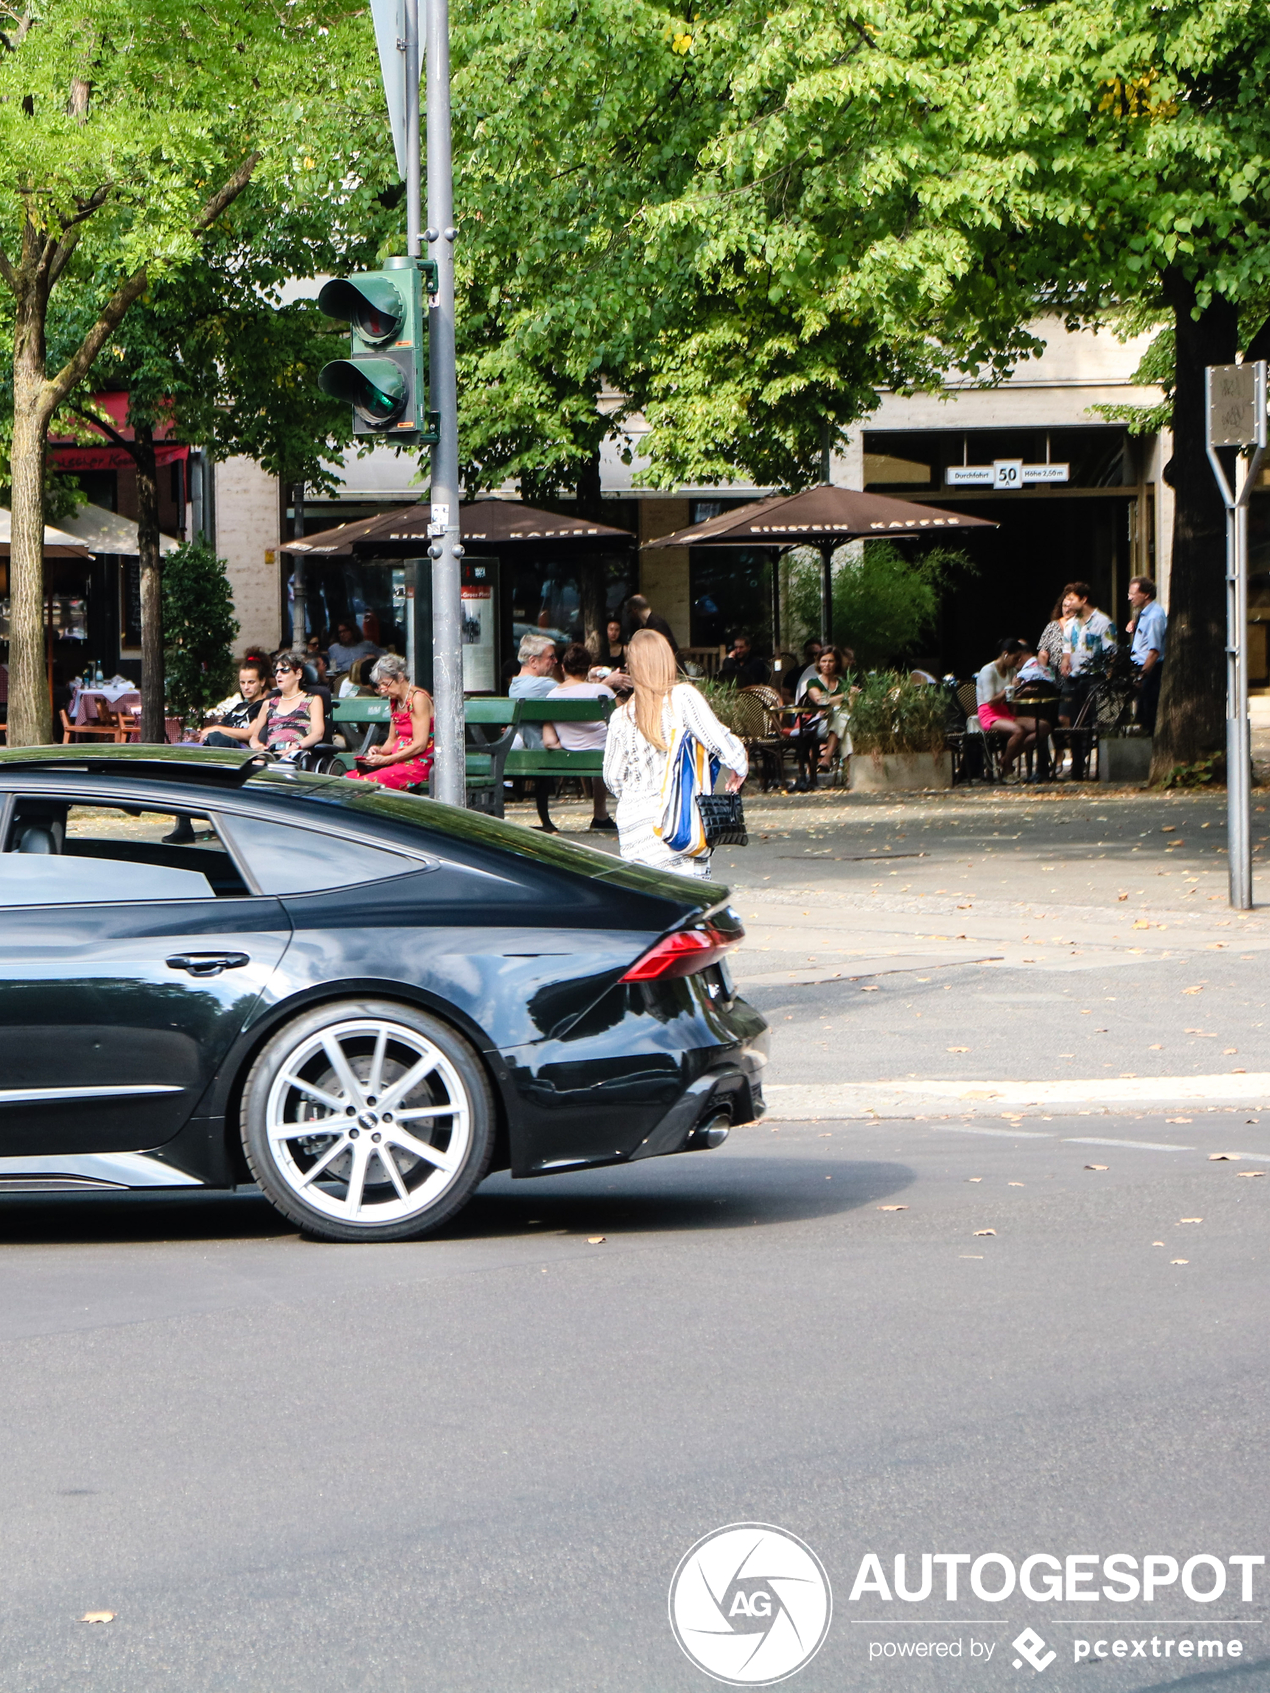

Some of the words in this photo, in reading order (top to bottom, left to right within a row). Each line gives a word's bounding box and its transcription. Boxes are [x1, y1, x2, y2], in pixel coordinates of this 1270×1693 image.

[998, 467, 1017, 481] 50
[749, 523, 848, 533] EINSTEIN
[869, 516, 961, 529] KAFFEE
[510, 528, 598, 539] KAFFEE
